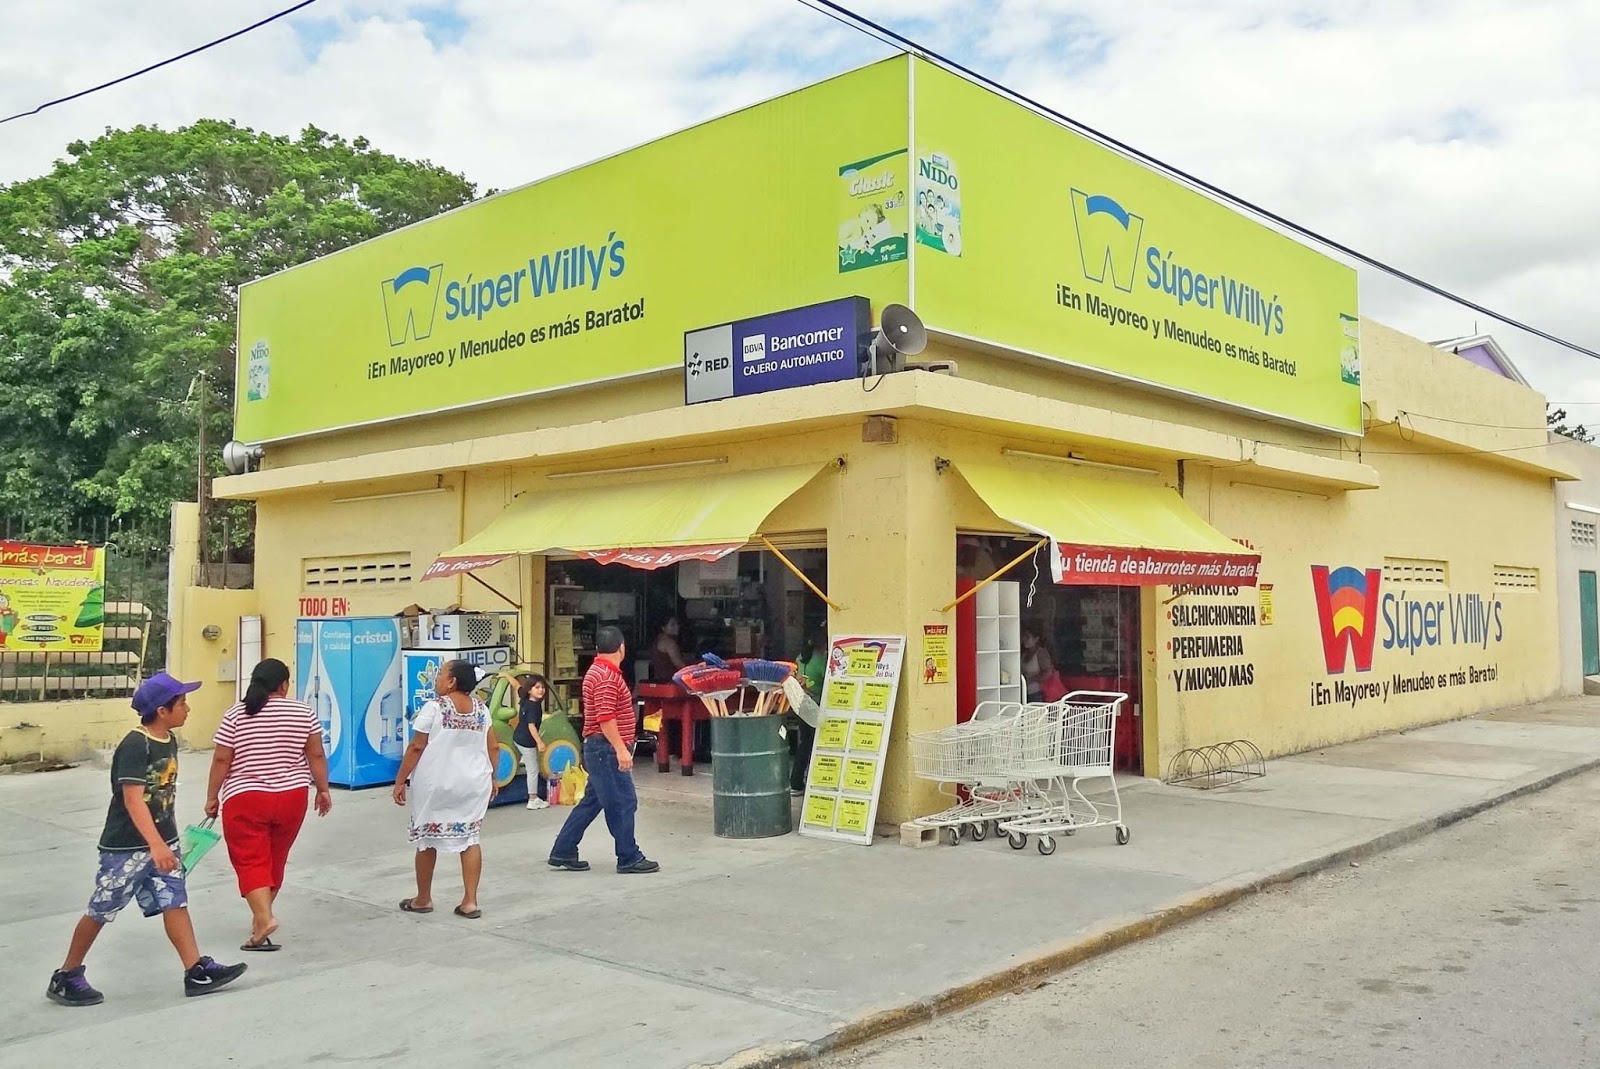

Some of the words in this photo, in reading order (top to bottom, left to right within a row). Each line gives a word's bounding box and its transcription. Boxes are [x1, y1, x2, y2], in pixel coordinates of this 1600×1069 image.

[919, 158, 958, 190] NIDO
[1146, 246, 1218, 309] Súper
[445, 273, 526, 321] Súper
[390, 351, 444, 376] Mayoreo
[448, 348, 456, 368] y
[460, 331, 526, 360] Menudeo
[530, 328, 546, 343] es
[548, 314, 580, 339] más
[585, 298, 645, 331] Barato!
[770, 327, 844, 352] Bancomer
[1086, 292, 1148, 331] Mayoreo
[1152, 318, 1160, 339] y
[1164, 318, 1222, 354] Menudeo
[1224, 342, 1237, 358] es
[1238, 345, 1260, 366] más
[1262, 351, 1296, 377] Barato!
[250, 348, 270, 361] NIDO
[744, 344, 764, 354] BBVA
[705, 357, 729, 372] RED
[743, 360, 778, 376] CAJERO
[780, 350, 844, 370] AUTOMATICO
[44, 546, 87, 566] bara!
[1075, 553, 1117, 574] tienda
[1120, 555, 1138, 574] de
[1138, 556, 1196, 576] abarrotes
[1197, 560, 1220, 576] más
[298, 598, 328, 617] TODO
[332, 598, 350, 616] EN:
[1172, 604, 1256, 628] SALCHICHONERIA
[1382, 590, 1444, 656] Súper
[1448, 592, 1502, 650] Willy's
[353, 630, 392, 644] cristal
[1172, 636, 1244, 659] PERFUMERIA
[458, 650, 508, 666] HIELO
[1174, 670, 1184, 692] Y
[1185, 666, 1228, 692] MUCHO
[1229, 664, 1254, 687] MAS
[1335, 680, 1380, 708] Mayoreo
[1383, 682, 1390, 703] y
[1393, 672, 1434, 694] Menudeo
[1438, 676, 1447, 688] es
[1450, 666, 1466, 688] más
[1469, 663, 1498, 685] Barato!
